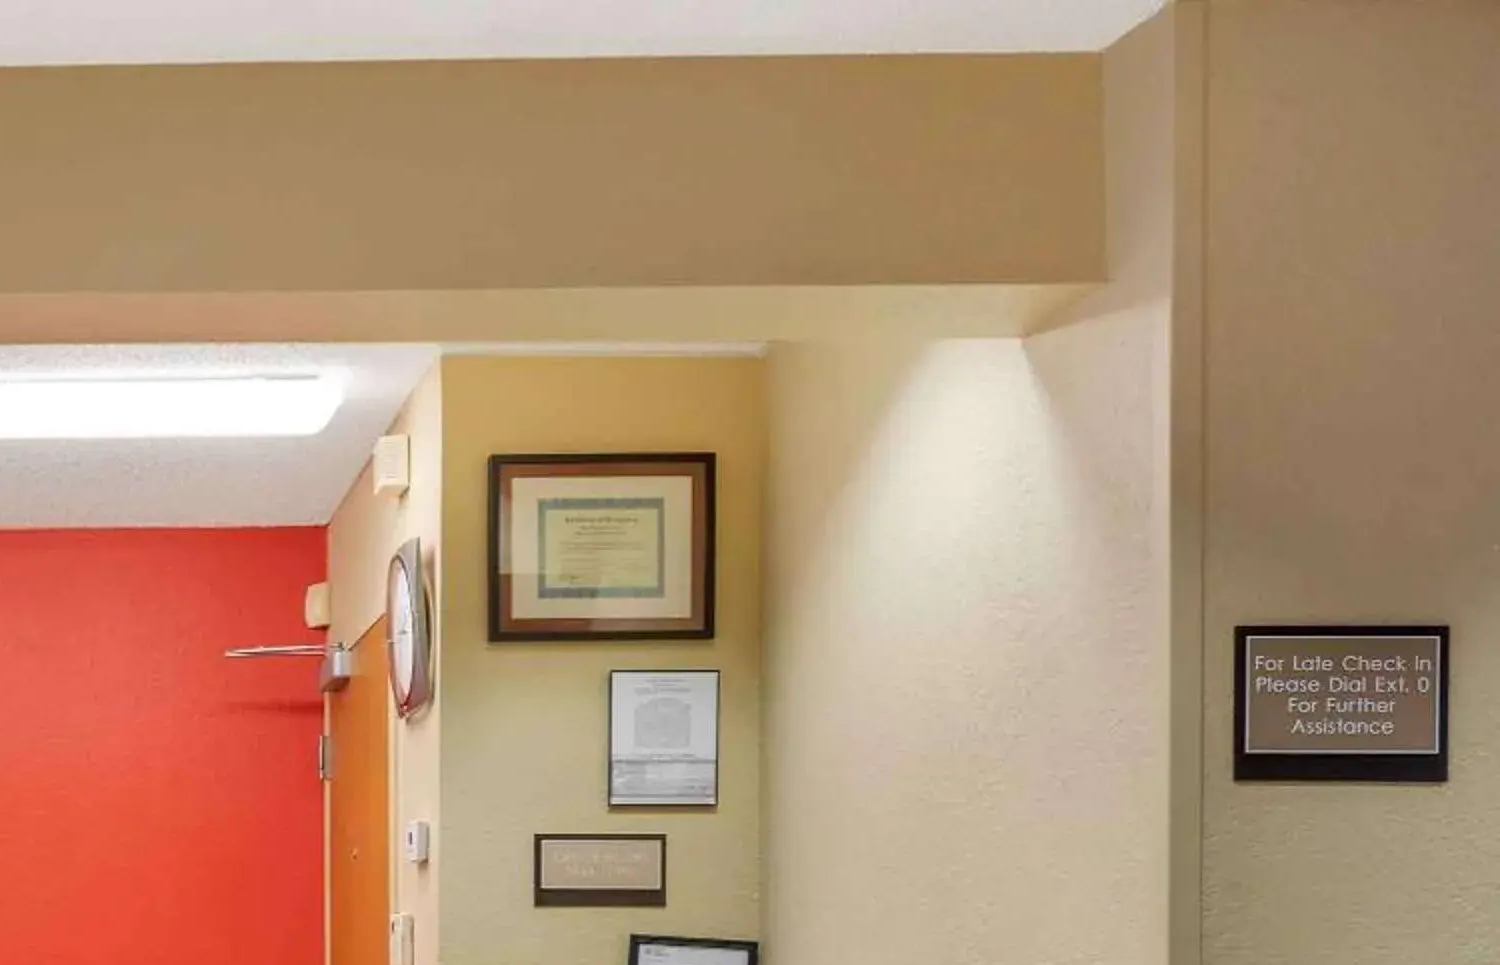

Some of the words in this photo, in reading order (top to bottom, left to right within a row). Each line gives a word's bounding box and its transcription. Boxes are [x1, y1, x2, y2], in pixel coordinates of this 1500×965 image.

[1254, 655, 1285, 672] For
[1292, 655, 1334, 672] Late
[1341, 655, 1406, 672] Check
[1414, 655, 1432, 672] In
[1254, 676, 1321, 694] Please
[1328, 676, 1367, 693] Dial
[1374, 676, 1410, 693] Ext.
[1287, 697, 1318, 713] For
[1325, 697, 1396, 713] Further
[1290, 718, 1395, 736] Assistance
